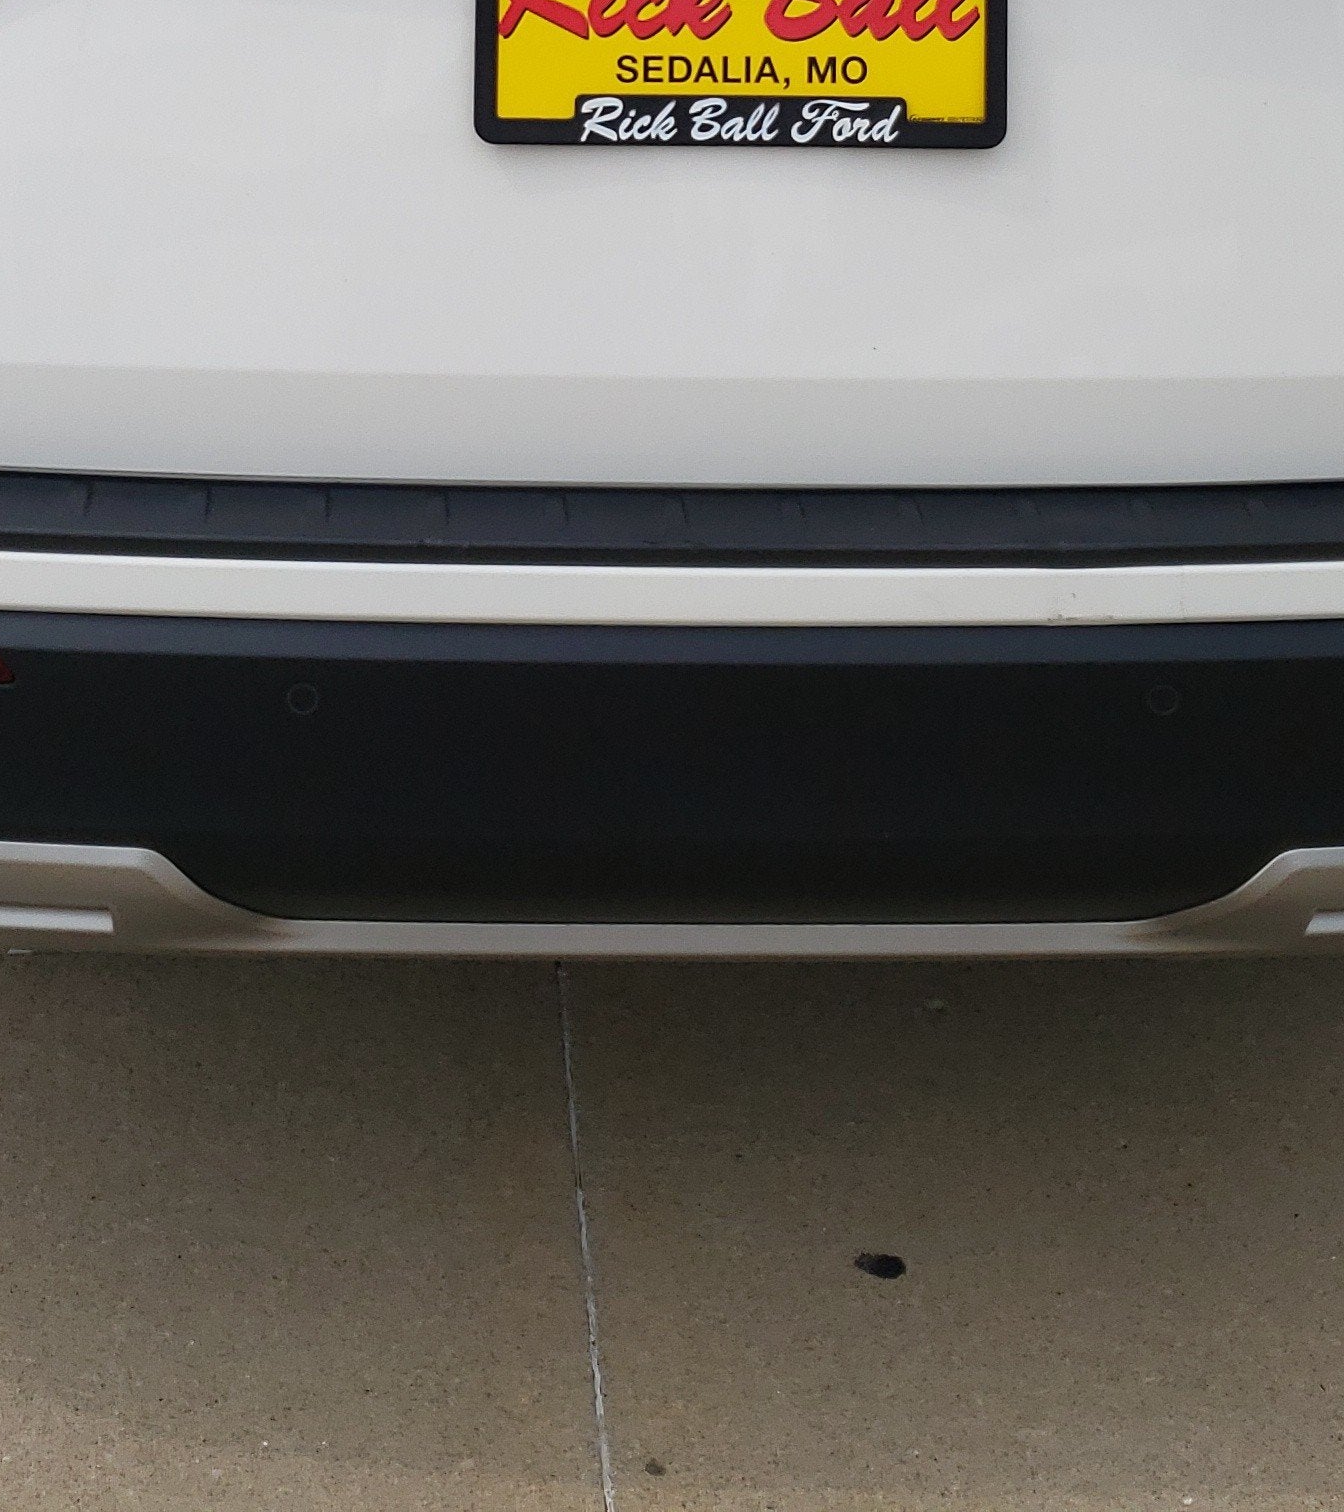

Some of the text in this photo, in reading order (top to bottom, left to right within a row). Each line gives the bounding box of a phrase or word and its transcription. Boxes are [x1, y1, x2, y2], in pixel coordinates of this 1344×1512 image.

[615, 55, 868, 89] SEDALIA, MO
[580, 96, 902, 144] Rick Ball Ford
